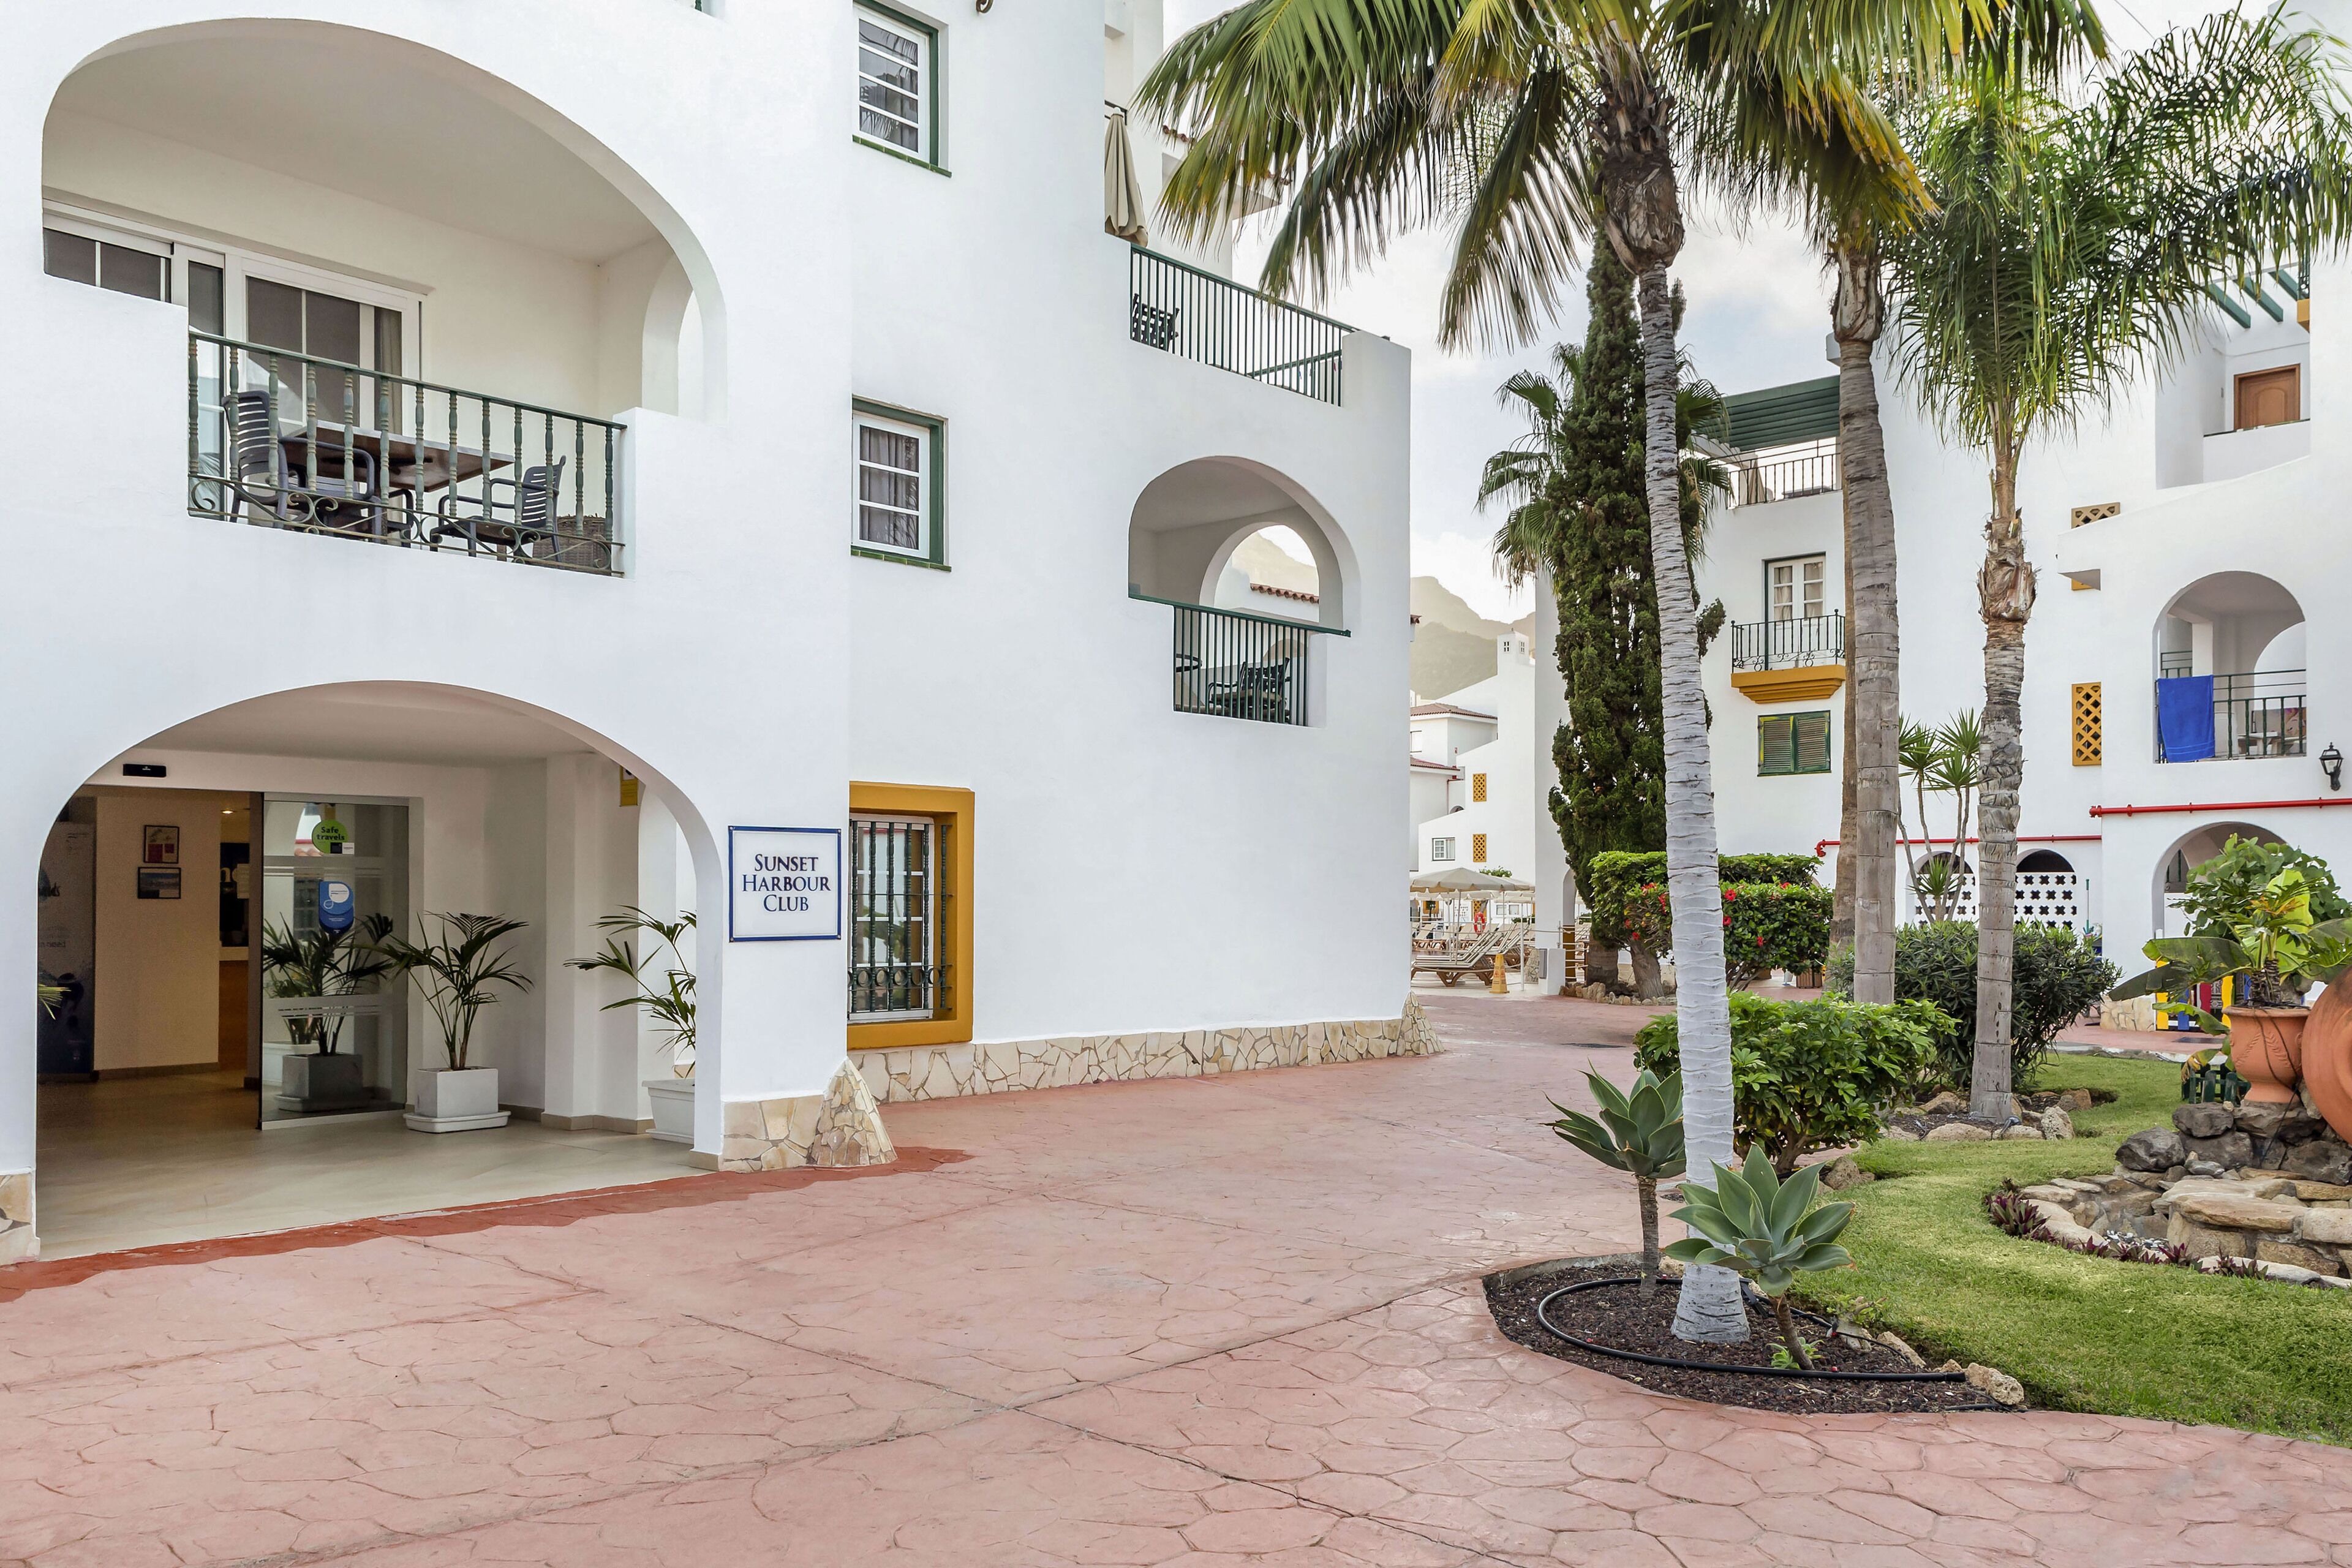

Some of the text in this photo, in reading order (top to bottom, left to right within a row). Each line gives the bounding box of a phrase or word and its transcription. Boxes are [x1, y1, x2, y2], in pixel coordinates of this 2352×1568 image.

[755, 854, 818, 872] SUNSET
[742, 875, 831, 892] HARBOUR
[763, 894, 809, 911] CLUB
